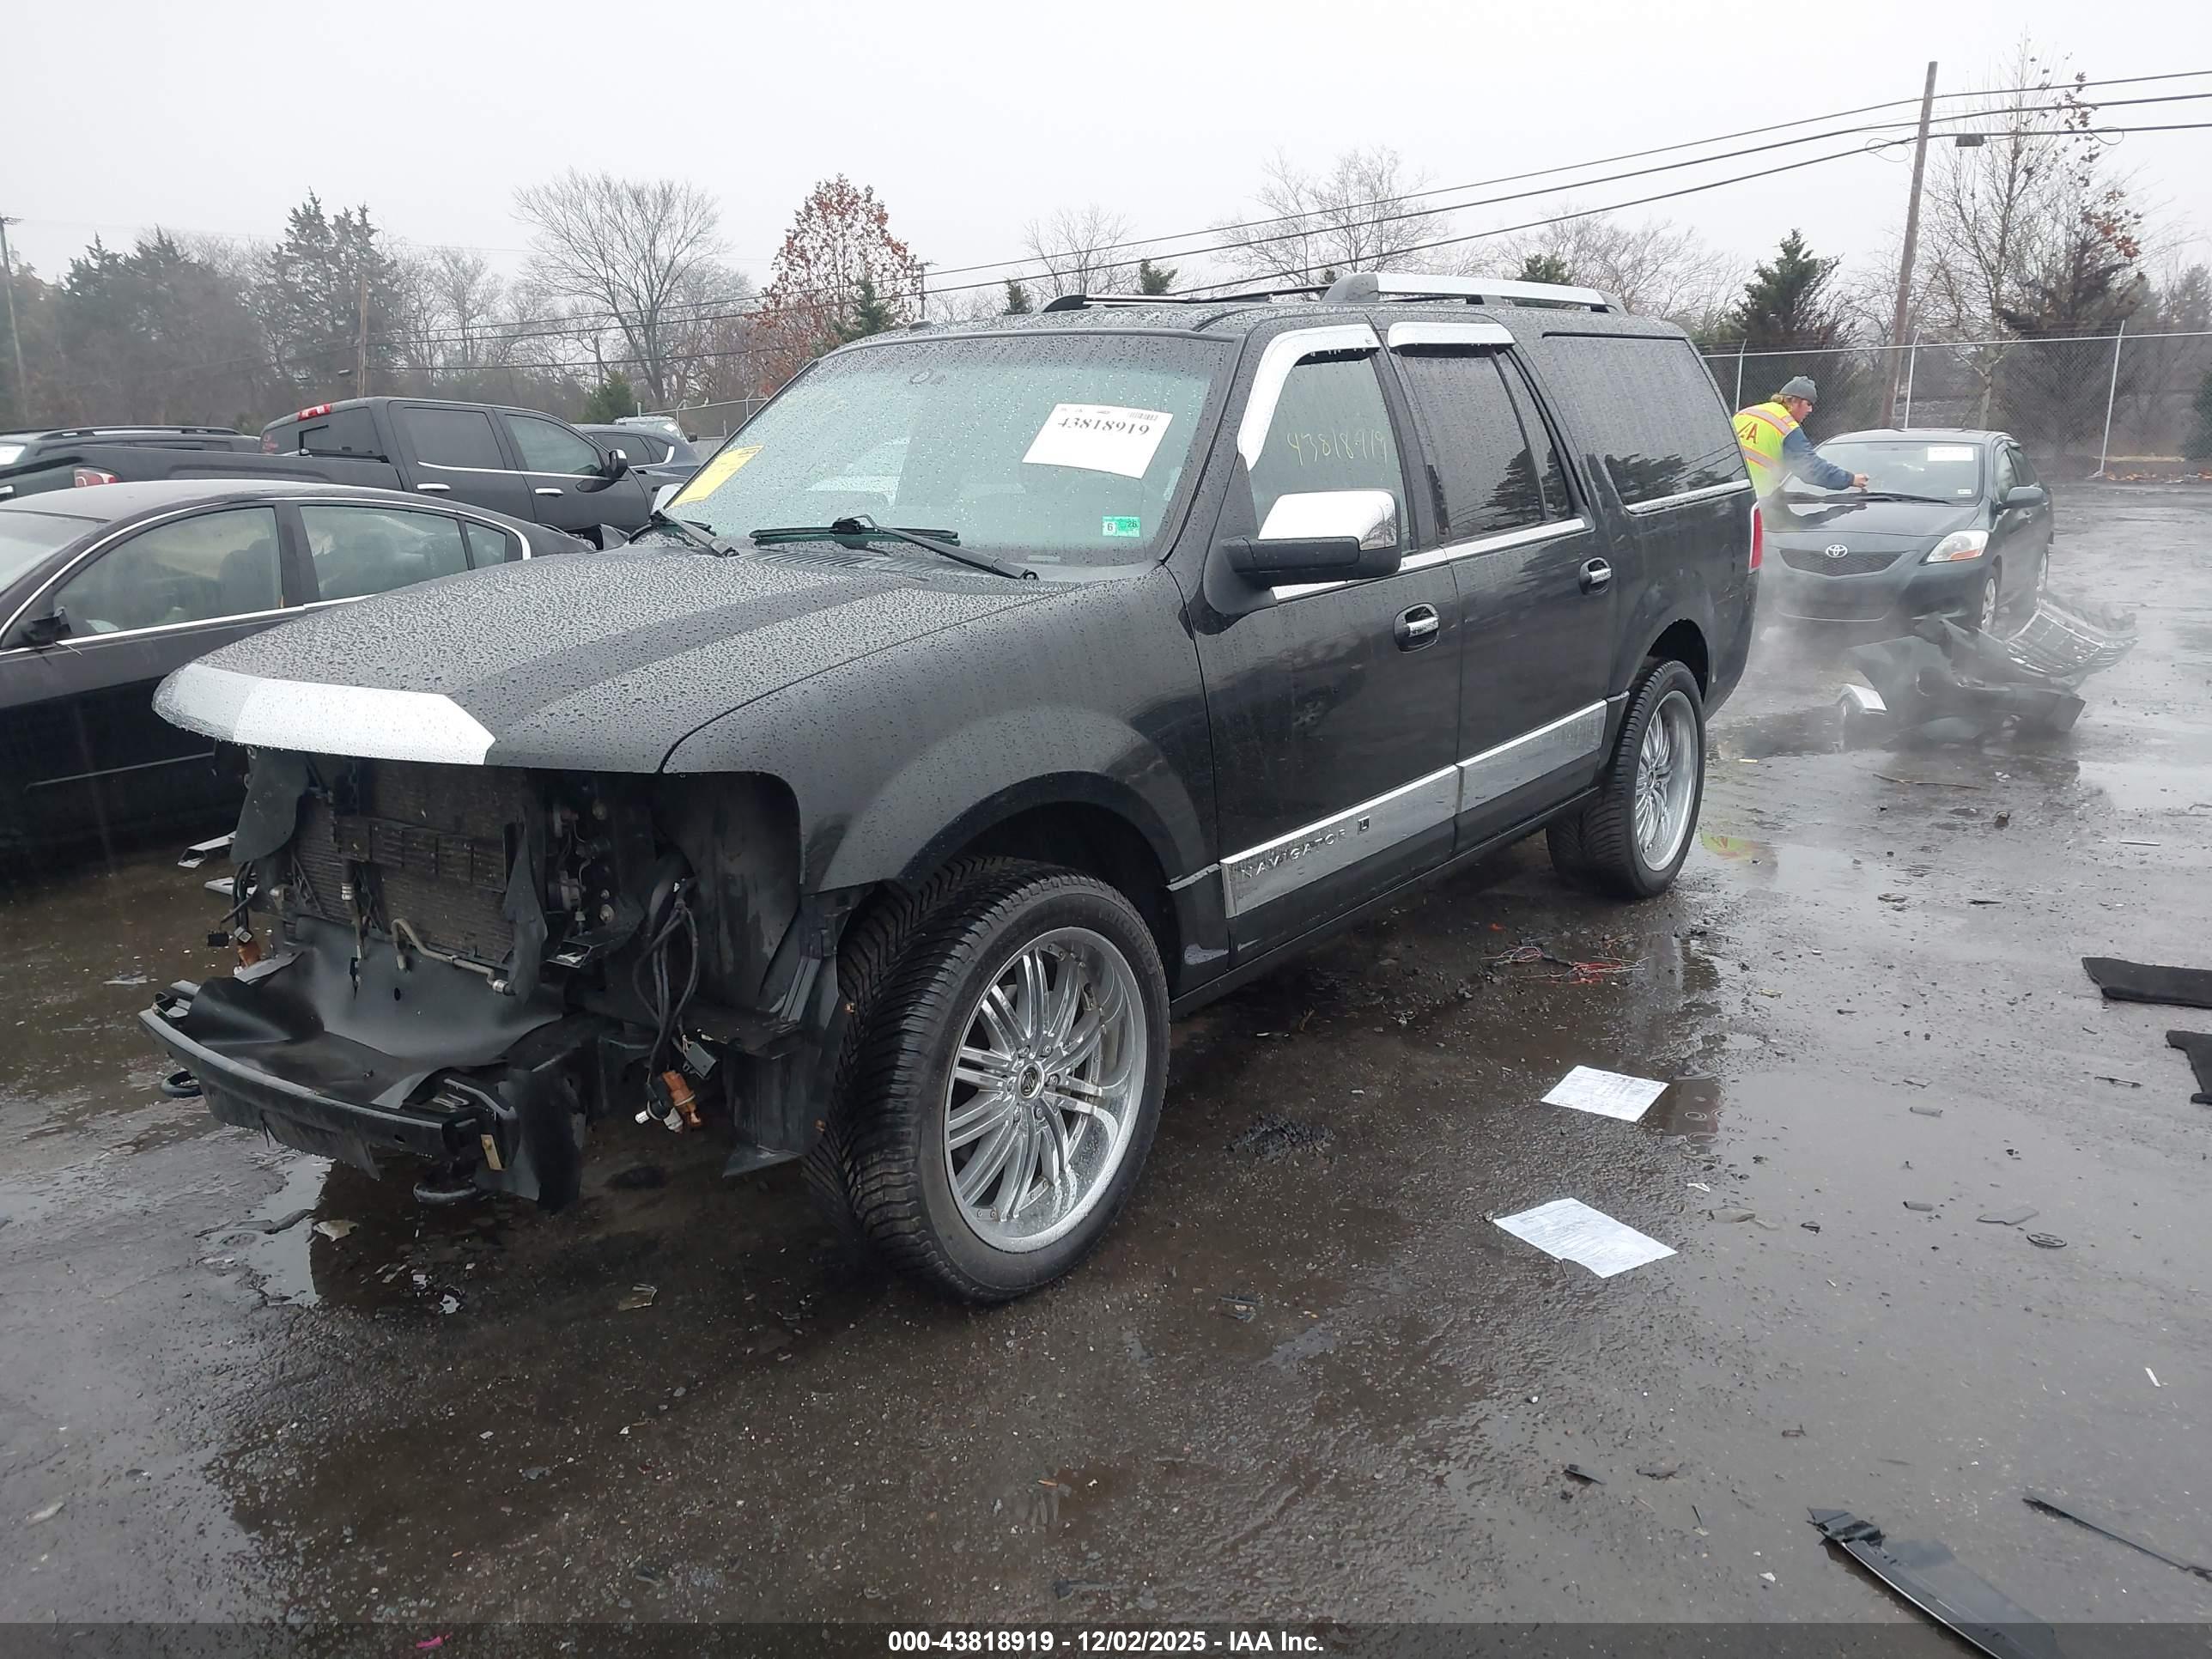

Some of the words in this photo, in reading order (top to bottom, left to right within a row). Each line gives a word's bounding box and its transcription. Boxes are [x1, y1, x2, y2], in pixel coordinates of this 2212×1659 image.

[1058, 417, 1150, 435] 43818919
[1107, 522, 1114, 532] 6
[1240, 828, 1346, 879] NAVIGATOR
